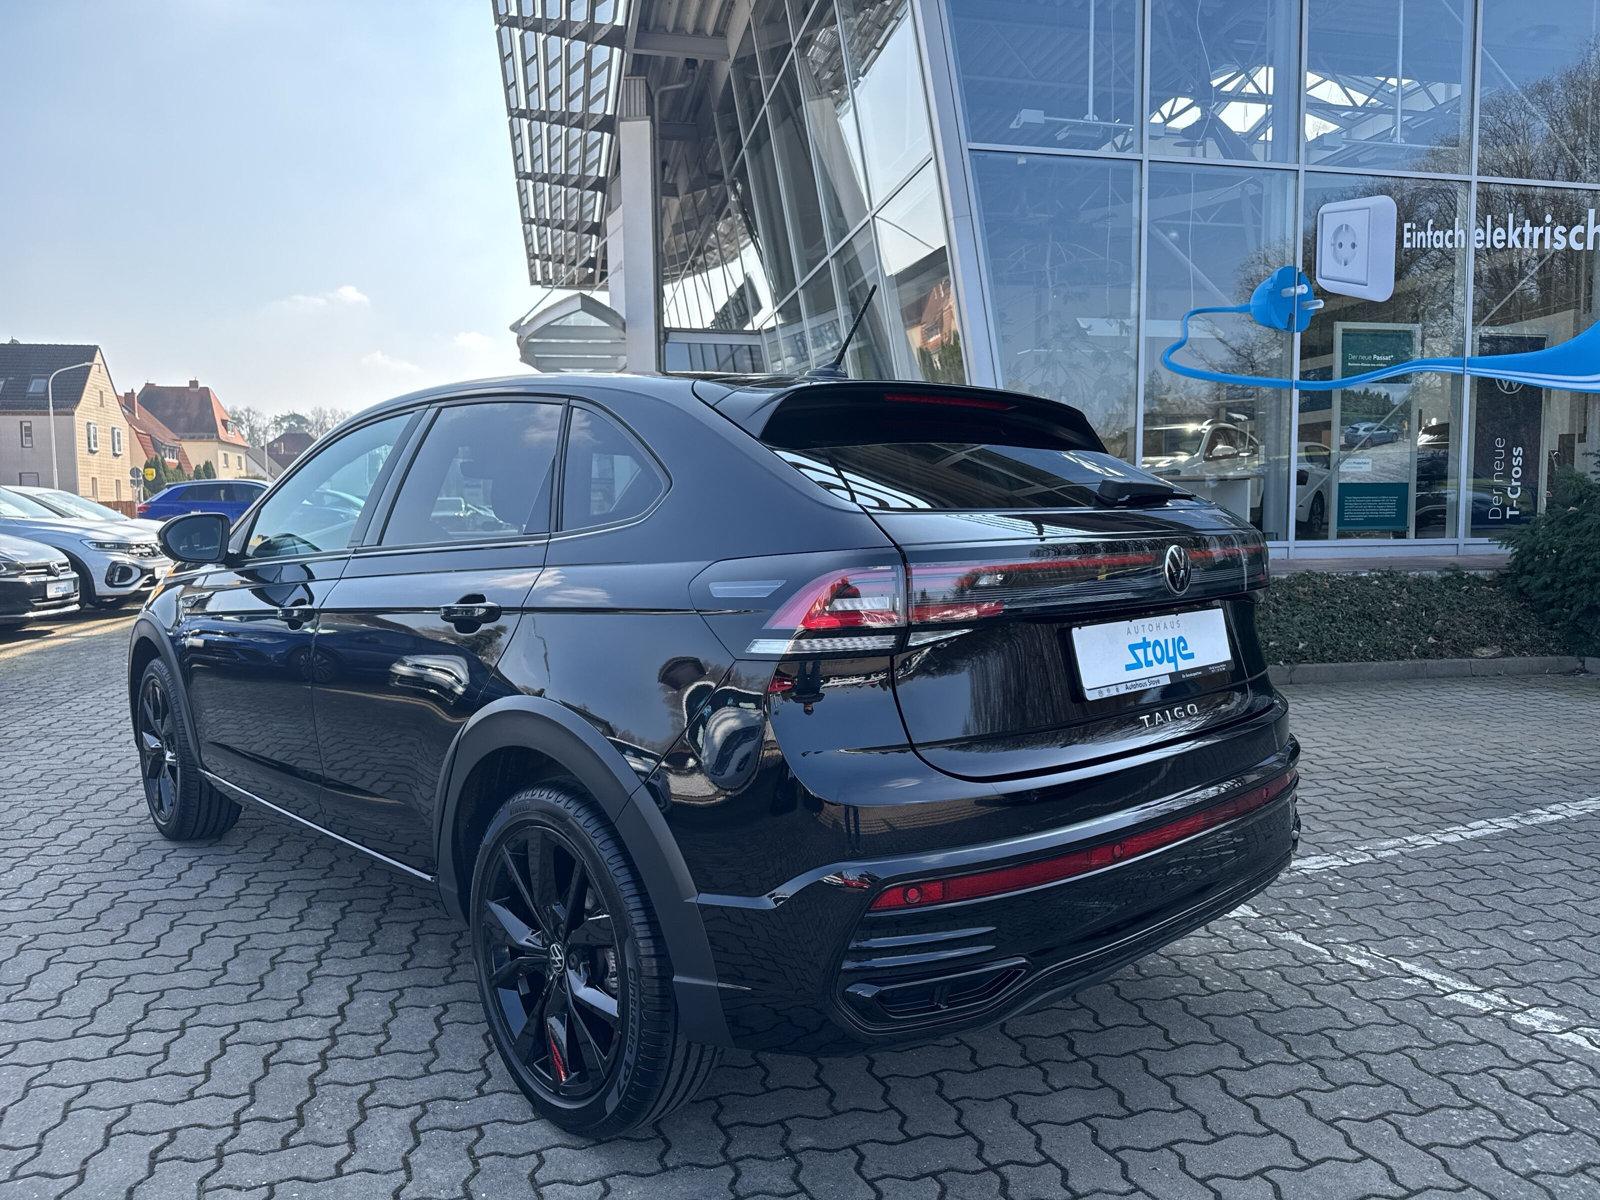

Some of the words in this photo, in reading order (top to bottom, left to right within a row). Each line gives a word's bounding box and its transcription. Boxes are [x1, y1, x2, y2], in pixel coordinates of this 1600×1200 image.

[1403, 217, 1465, 249] Einfach
[1475, 208, 1600, 251] elektrisch
[1493, 437, 1506, 482] neue
[1506, 446, 1523, 519] T-Cross
[1488, 488, 1503, 519] Der
[1126, 619, 1182, 636] AUTOHAUS
[1125, 680, 1148, 691] Autohaus
[1139, 703, 1199, 728] TAIGO
